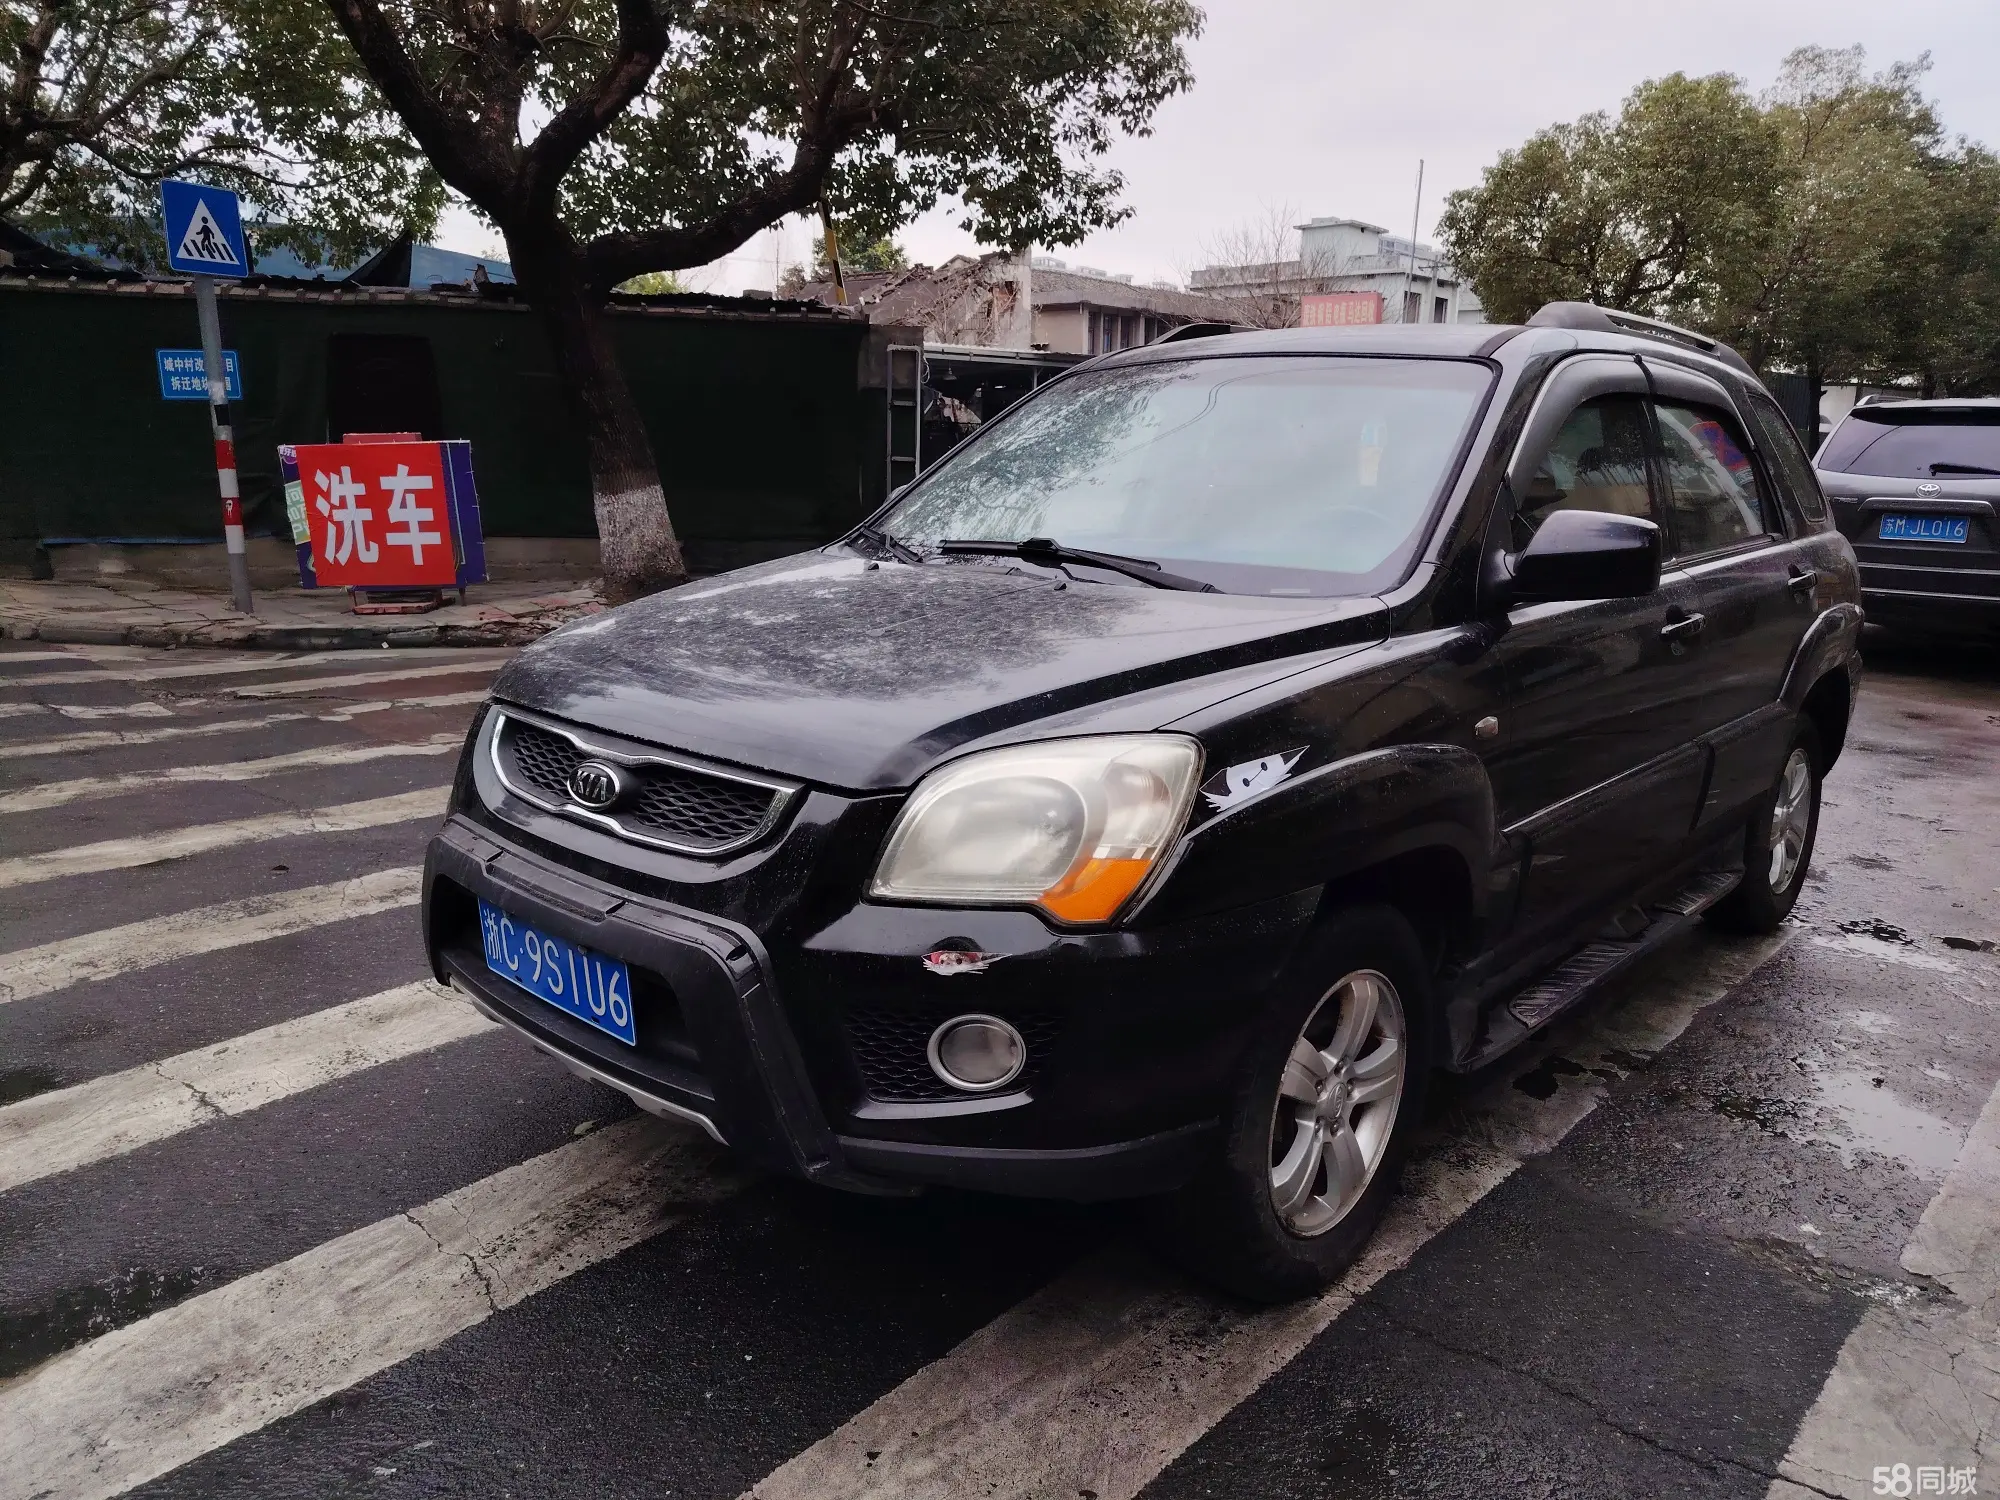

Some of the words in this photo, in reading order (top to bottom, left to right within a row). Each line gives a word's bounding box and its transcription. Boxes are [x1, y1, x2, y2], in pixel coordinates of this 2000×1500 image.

[164, 357, 234, 372] 城中村改目
[314, 463, 442, 566] 洗车
[573, 769, 607, 801] KIA
